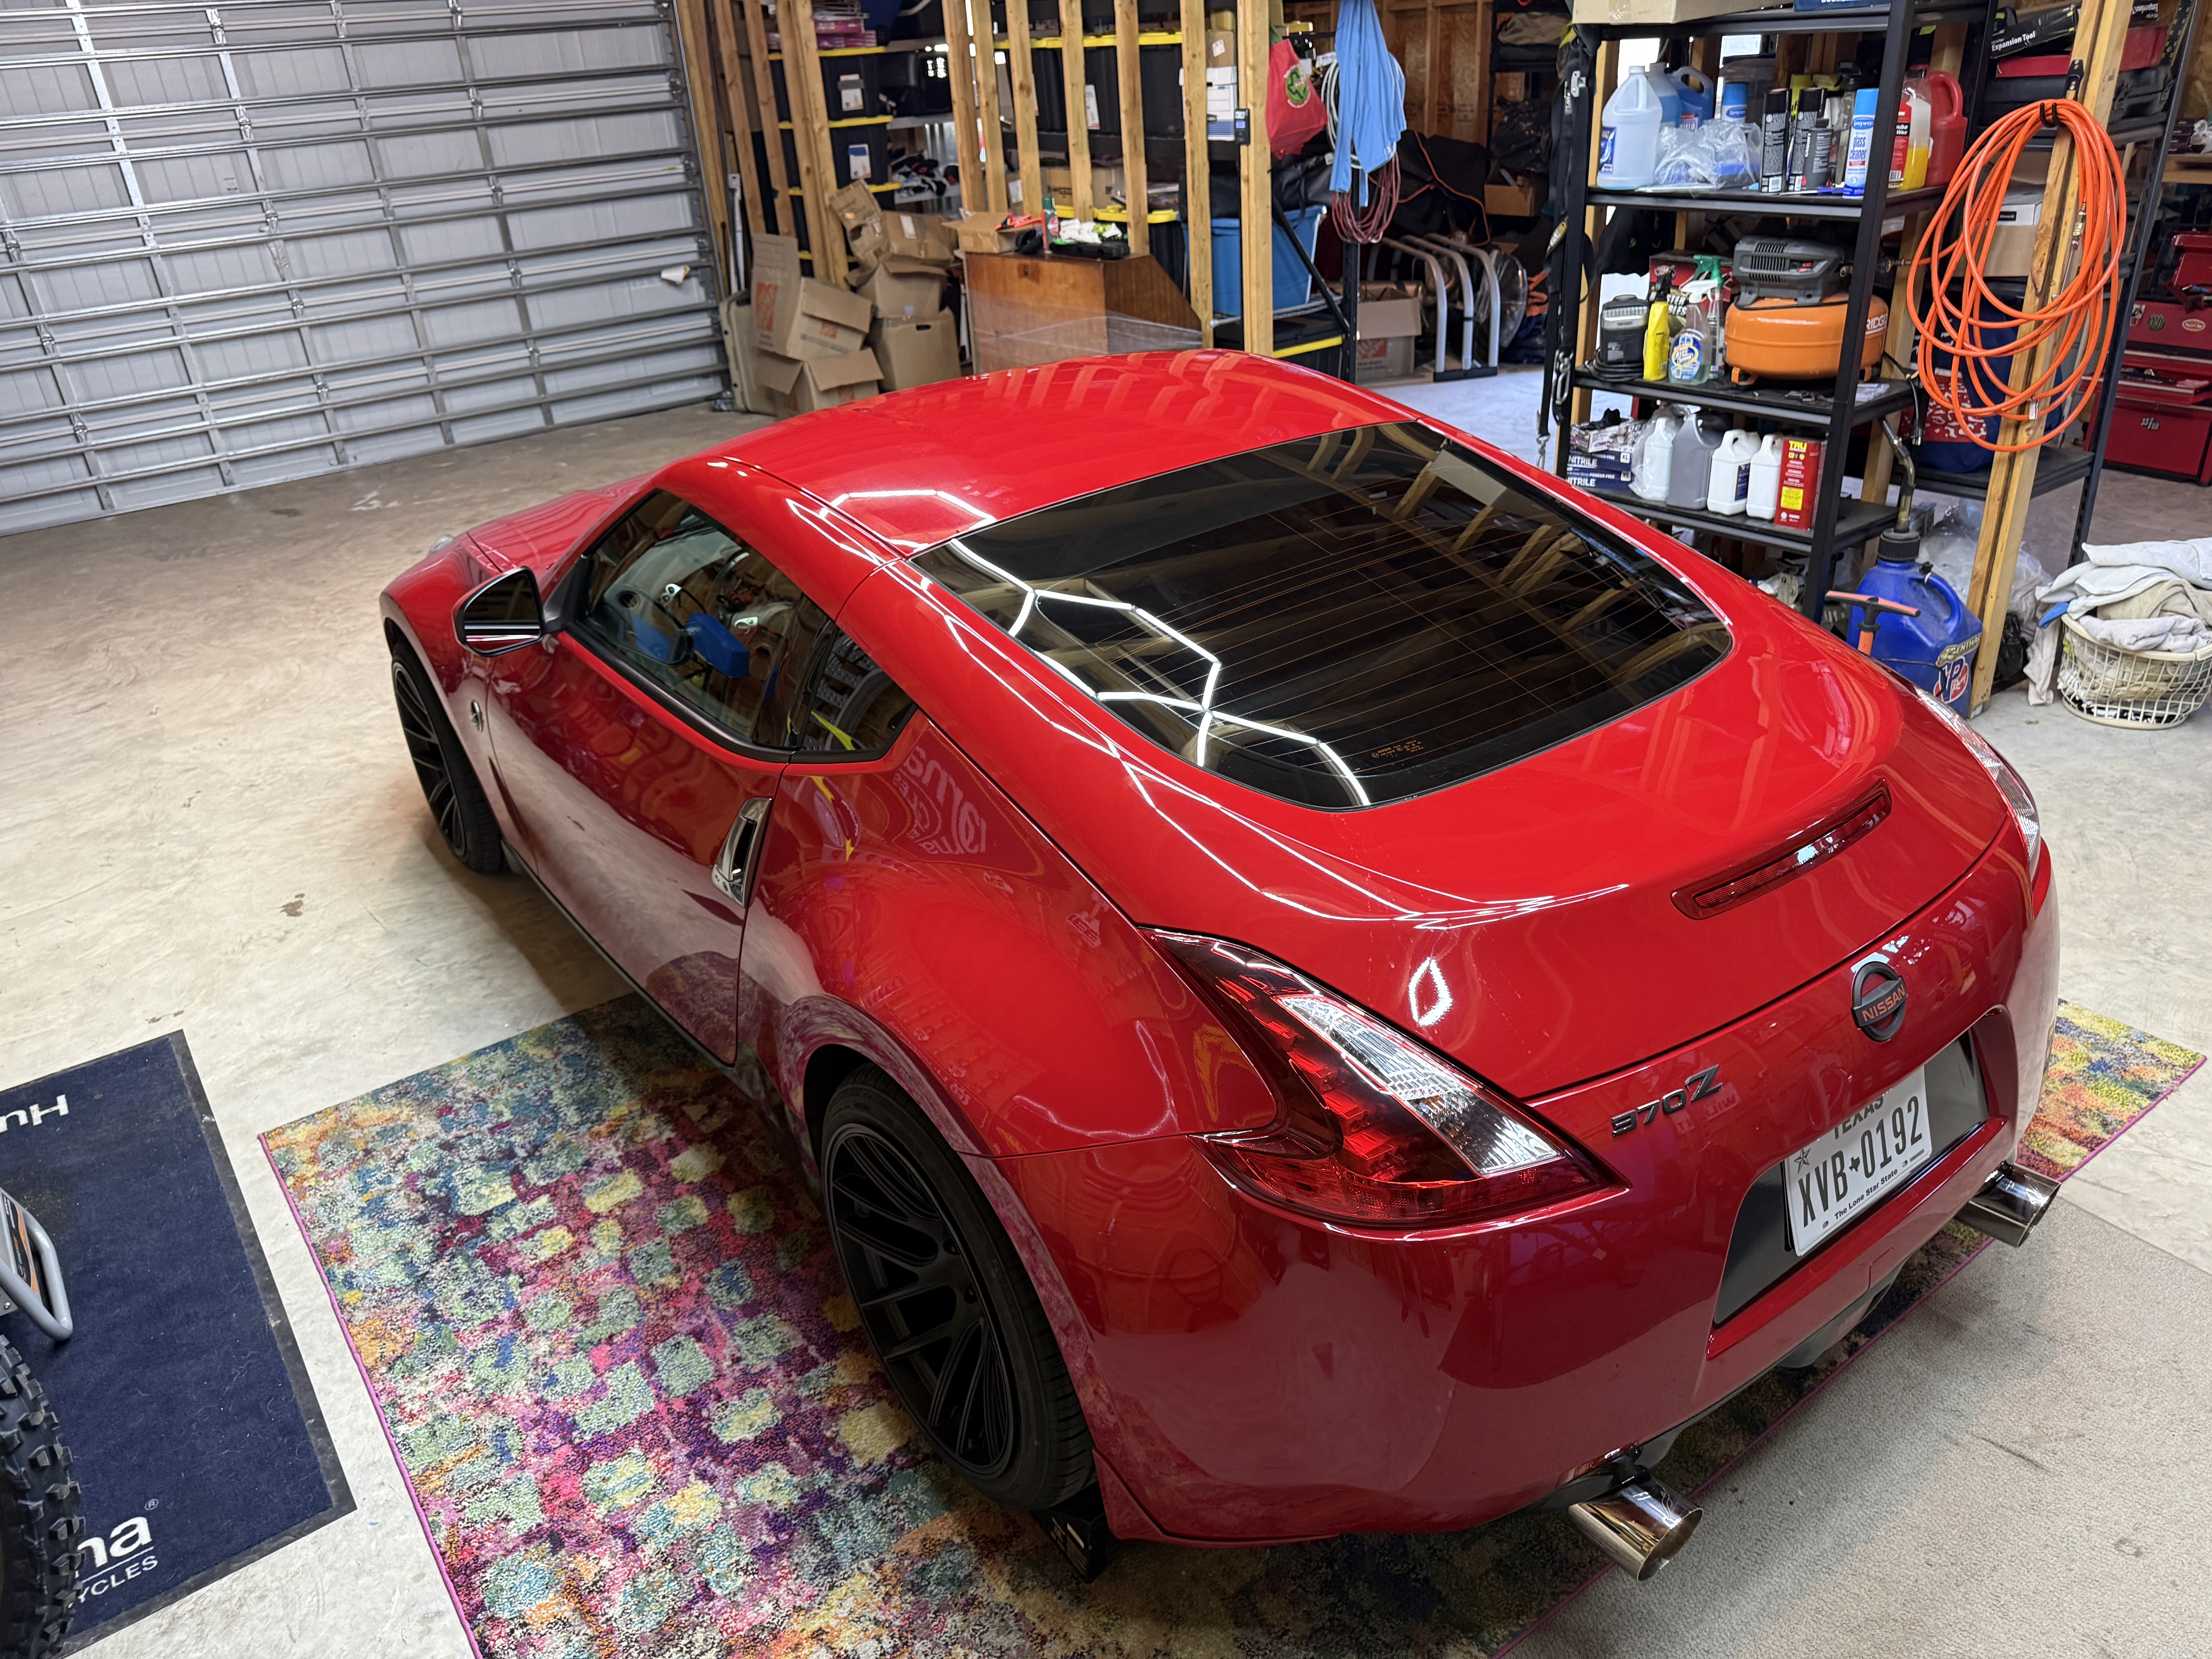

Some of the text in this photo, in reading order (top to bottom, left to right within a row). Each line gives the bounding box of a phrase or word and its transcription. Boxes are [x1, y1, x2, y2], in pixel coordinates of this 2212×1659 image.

[1991, 31, 2035, 52] Expansion Tool
[1850, 149, 1867, 160] cleaner
[1853, 135, 1866, 148] glass
[1568, 454, 1598, 467] NITRILE
[1862, 984, 1906, 1022] NISSAN
[1611, 1063, 1723, 1138] 370Z
[1834, 1169, 1898, 1220] The Lone Star State
[68, 1554, 158, 1608] YCLES
